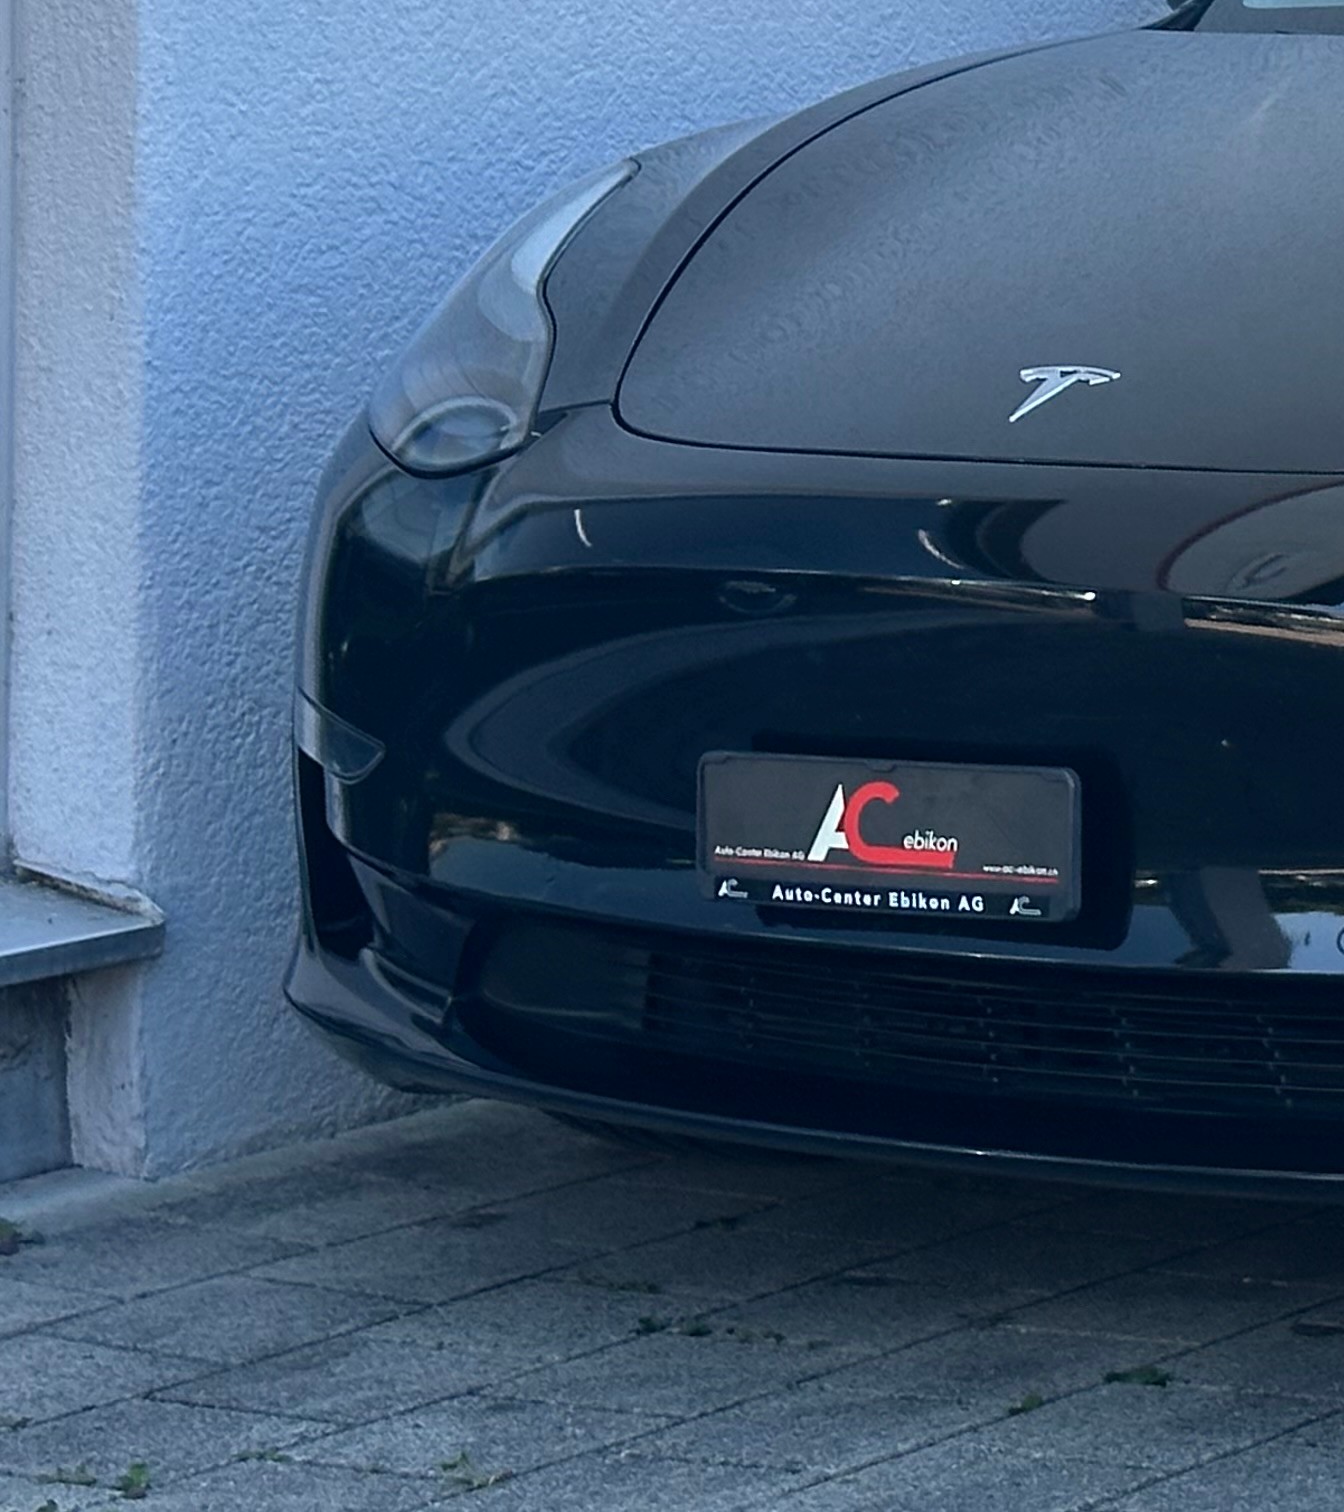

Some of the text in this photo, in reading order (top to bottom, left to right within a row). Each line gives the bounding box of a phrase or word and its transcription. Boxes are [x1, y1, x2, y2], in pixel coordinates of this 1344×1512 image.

[808, 781, 957, 869] AC ebikon
[772, 885, 984, 912] Auto-Center Ebikon AG
